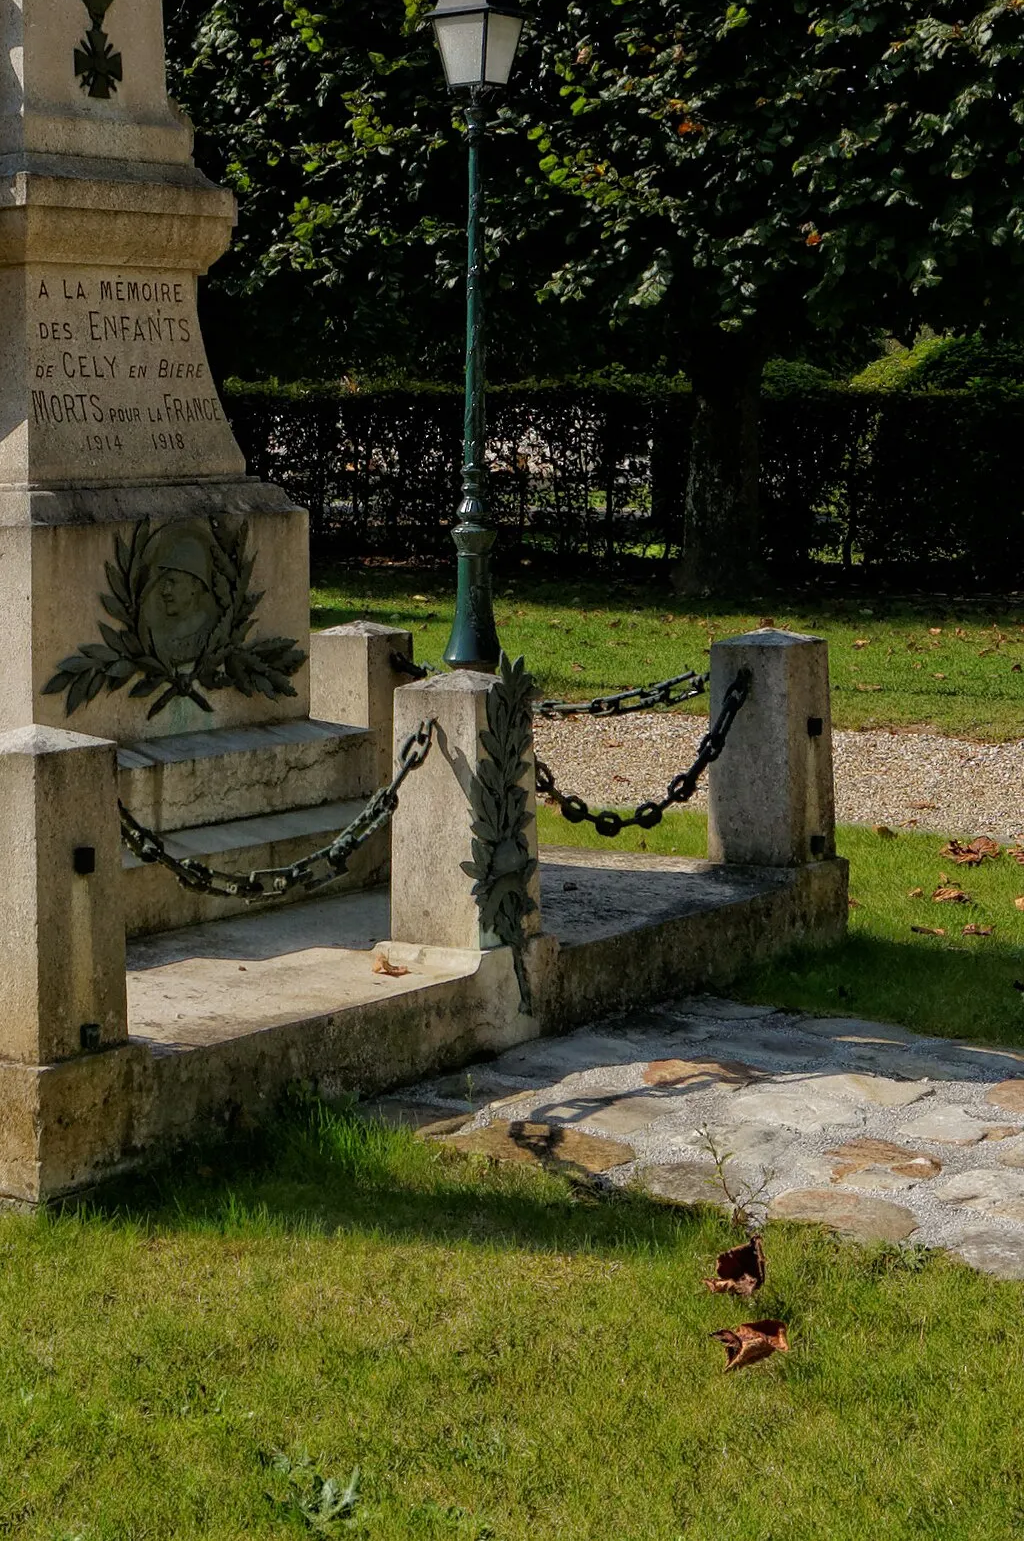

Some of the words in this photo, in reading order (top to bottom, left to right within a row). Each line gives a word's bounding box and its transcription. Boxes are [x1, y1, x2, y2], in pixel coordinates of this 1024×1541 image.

[63, 278, 86, 300] LA
[39, 322, 73, 340] DES
[88, 310, 191, 342] ENFANTS
[35, 363, 54, 378] DE
[62, 351, 117, 378] CELY
[128, 364, 147, 378] EN
[158, 358, 204, 378] BIERE
[31, 389, 104, 424] MORTS
[109, 407, 140, 422] POUR
[148, 408, 163, 422] LA
[163, 393, 222, 422] FRANCE
[86, 435, 123, 451] 1914
[151, 433, 185, 450] 1918
